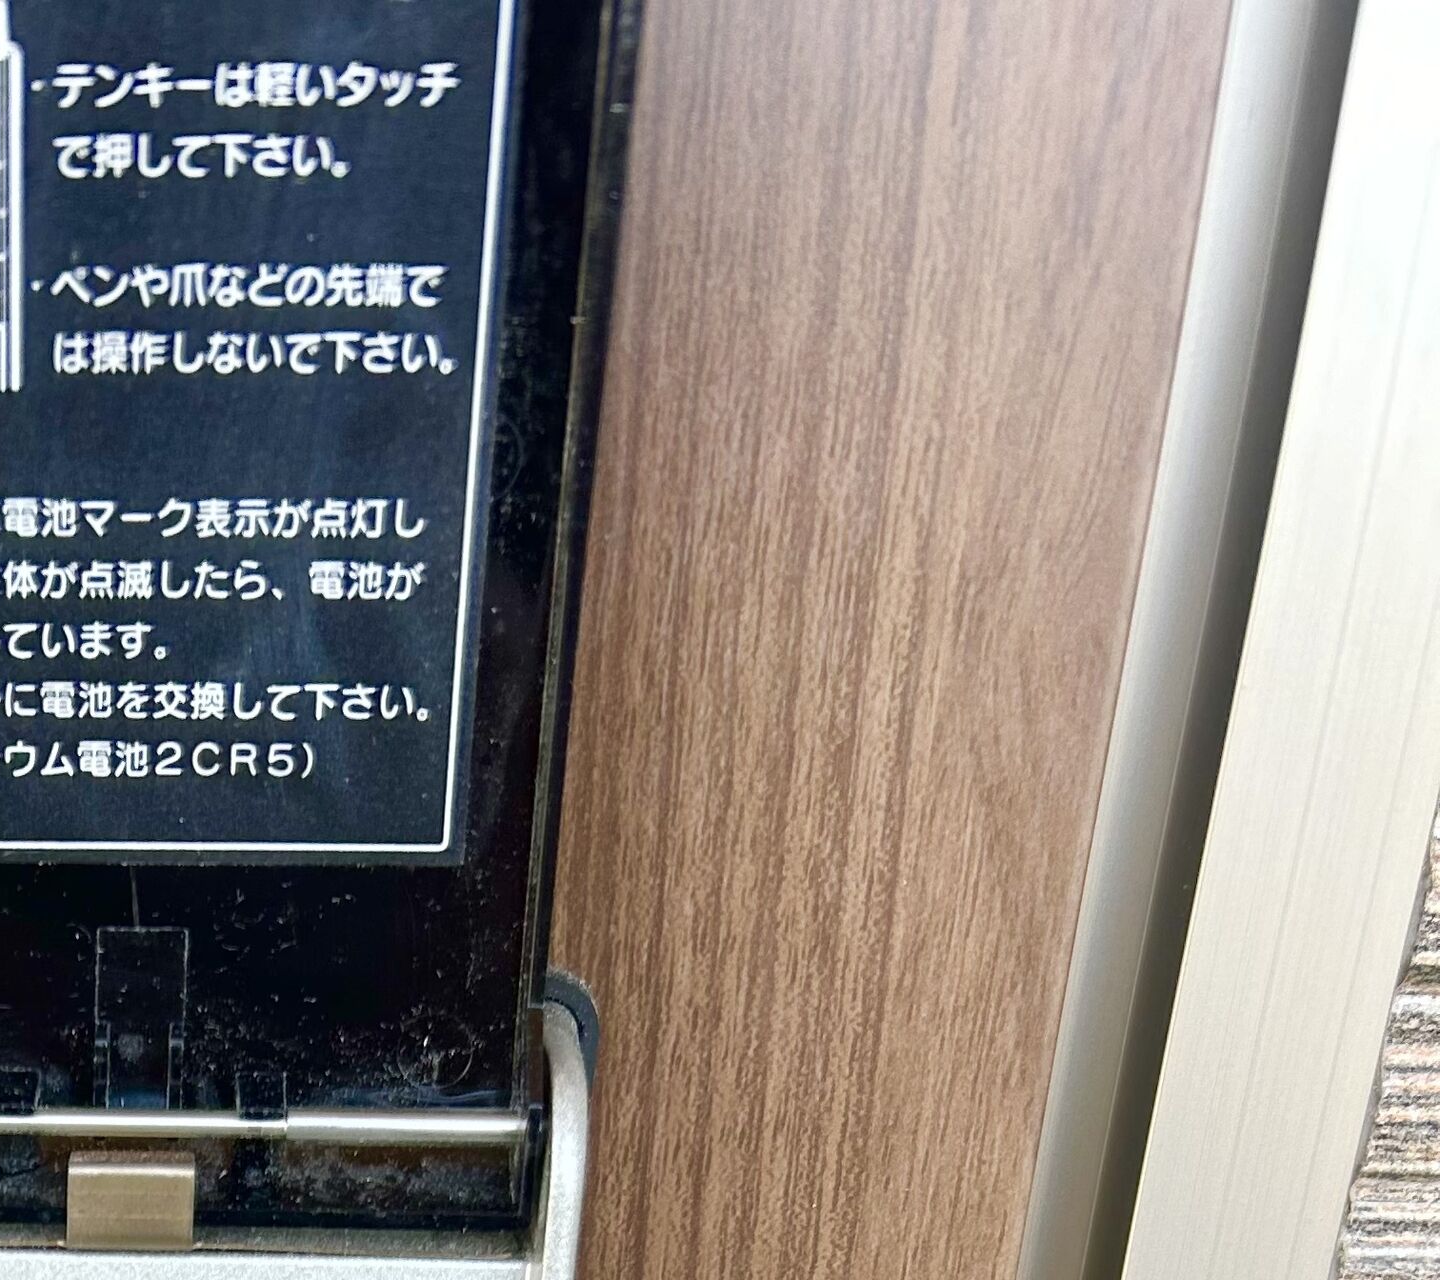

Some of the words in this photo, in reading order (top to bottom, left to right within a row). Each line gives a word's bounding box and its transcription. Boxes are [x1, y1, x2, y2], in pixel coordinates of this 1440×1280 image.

[52, 133, 350, 179] で押して下さい。
[53, 331, 455, 375] は操作しないで下さい。
